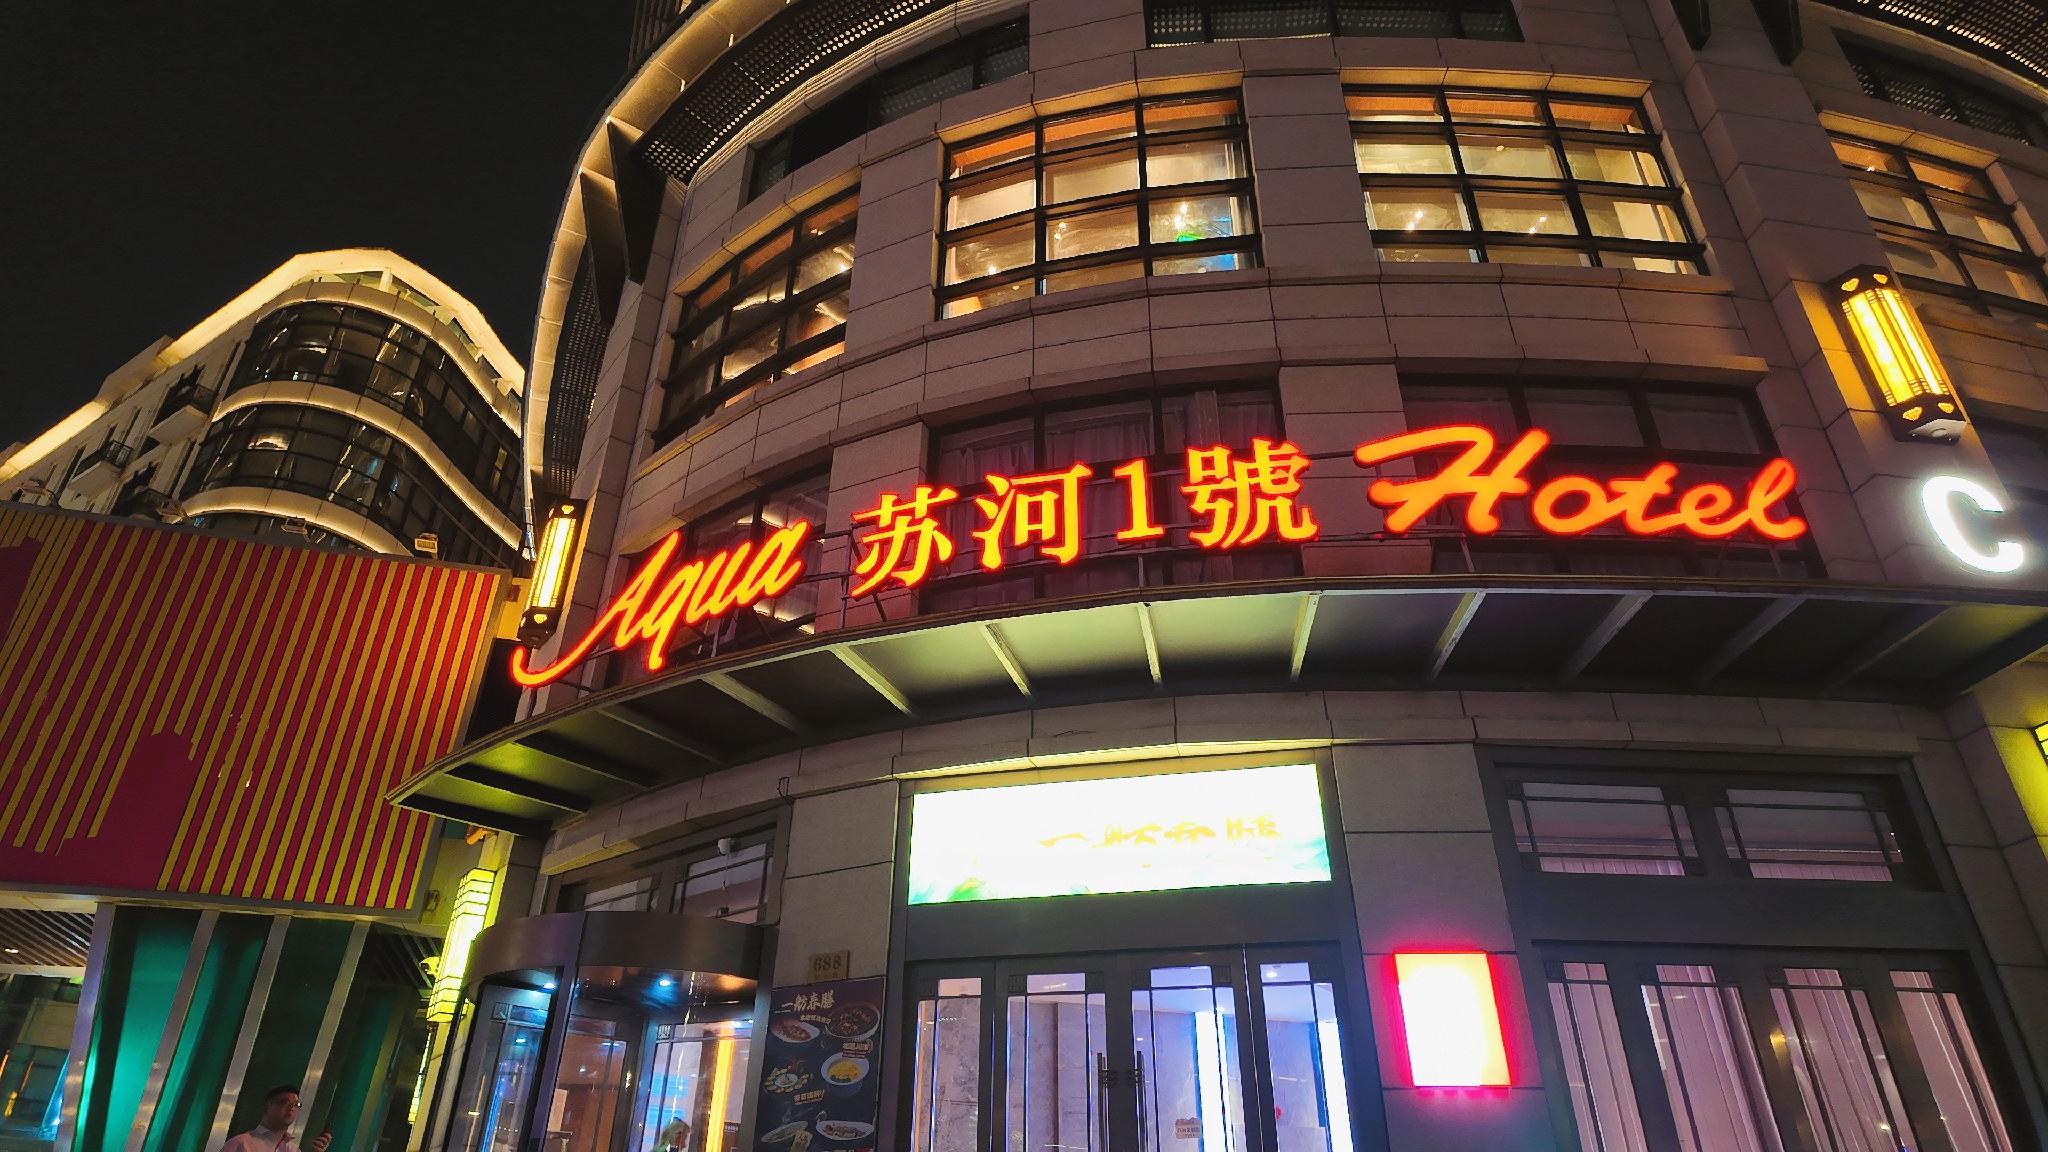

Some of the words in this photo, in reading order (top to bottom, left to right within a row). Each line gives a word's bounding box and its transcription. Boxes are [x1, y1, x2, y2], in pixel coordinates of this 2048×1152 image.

[510, 520, 811, 686] Aqua
[850, 437, 1319, 599] 苏河1號
[1355, 425, 1807, 539] Hotel
[1921, 475, 2025, 574] C
[813, 955, 842, 972] 688
